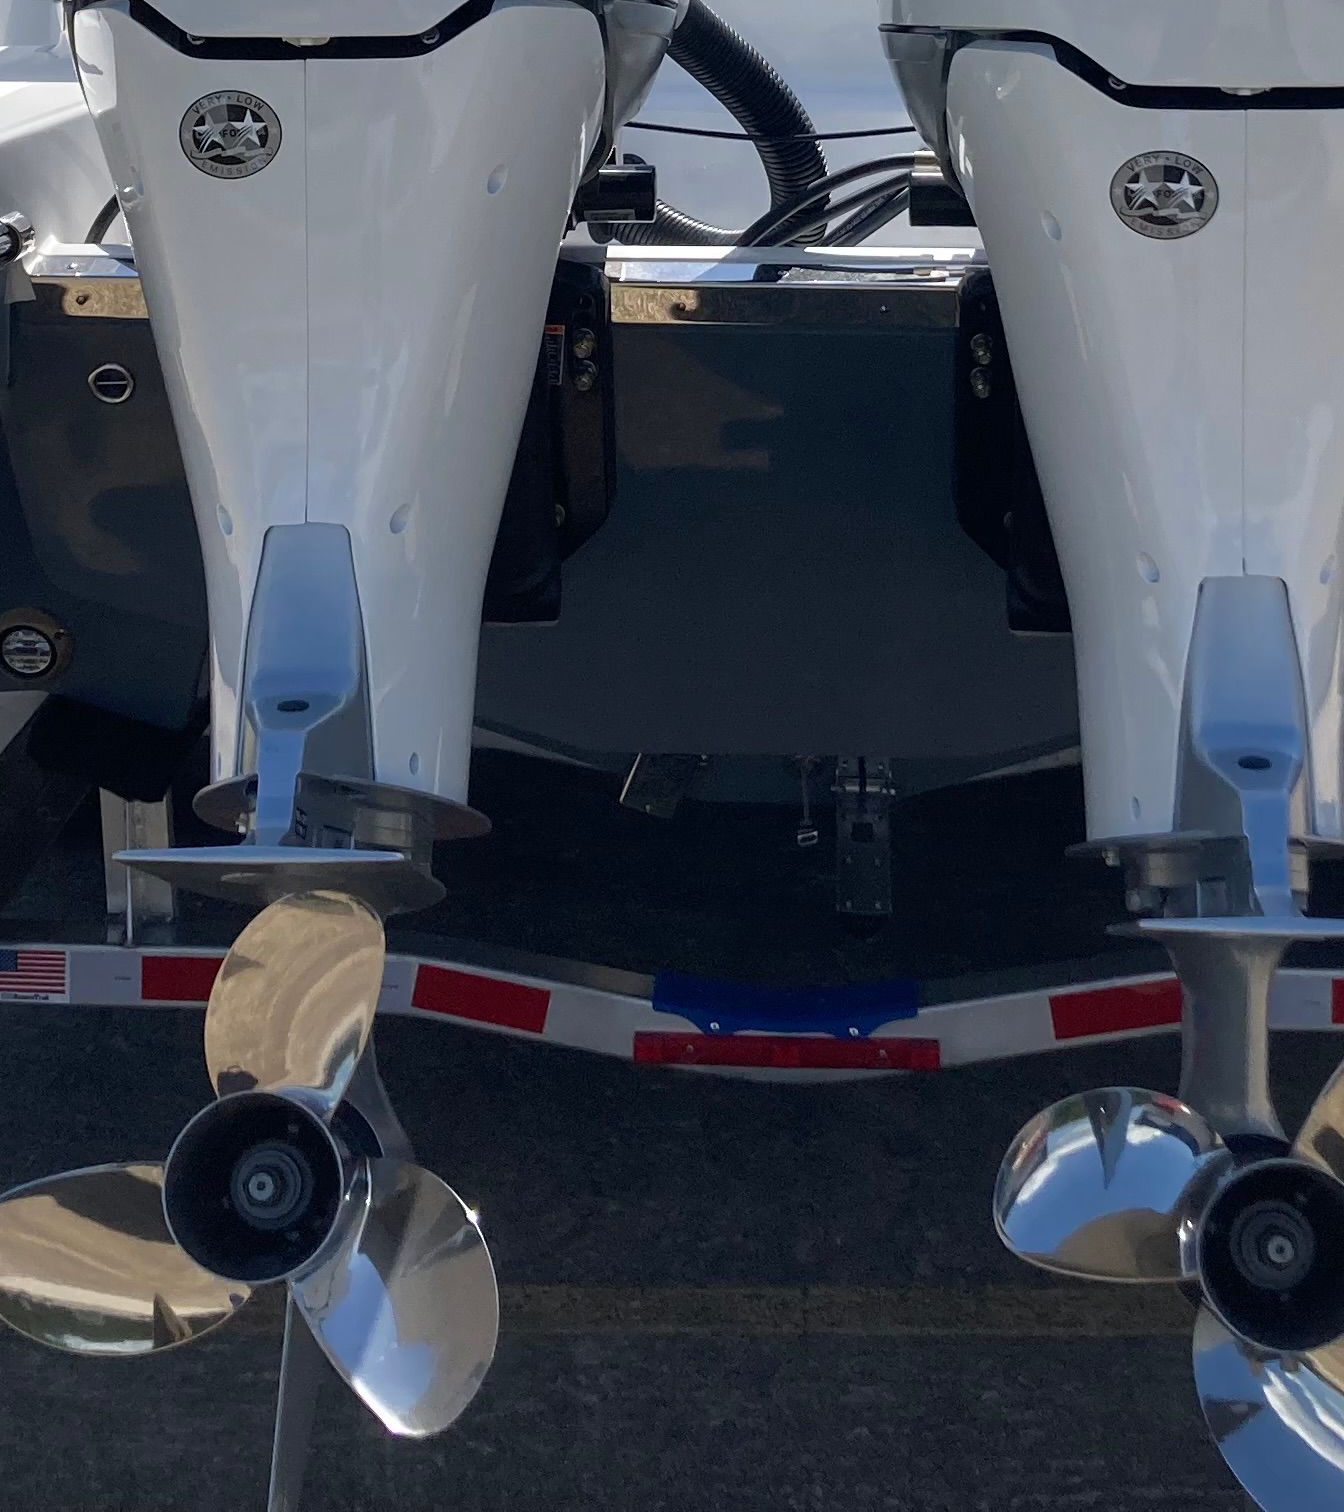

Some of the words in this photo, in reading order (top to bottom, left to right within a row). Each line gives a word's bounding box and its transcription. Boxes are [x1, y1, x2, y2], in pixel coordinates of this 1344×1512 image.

[191, 94, 223, 116] VERY
[236, 94, 265, 112] LOW
[1126, 154, 1161, 173] VERY
[1174, 155, 1205, 176] LOW
